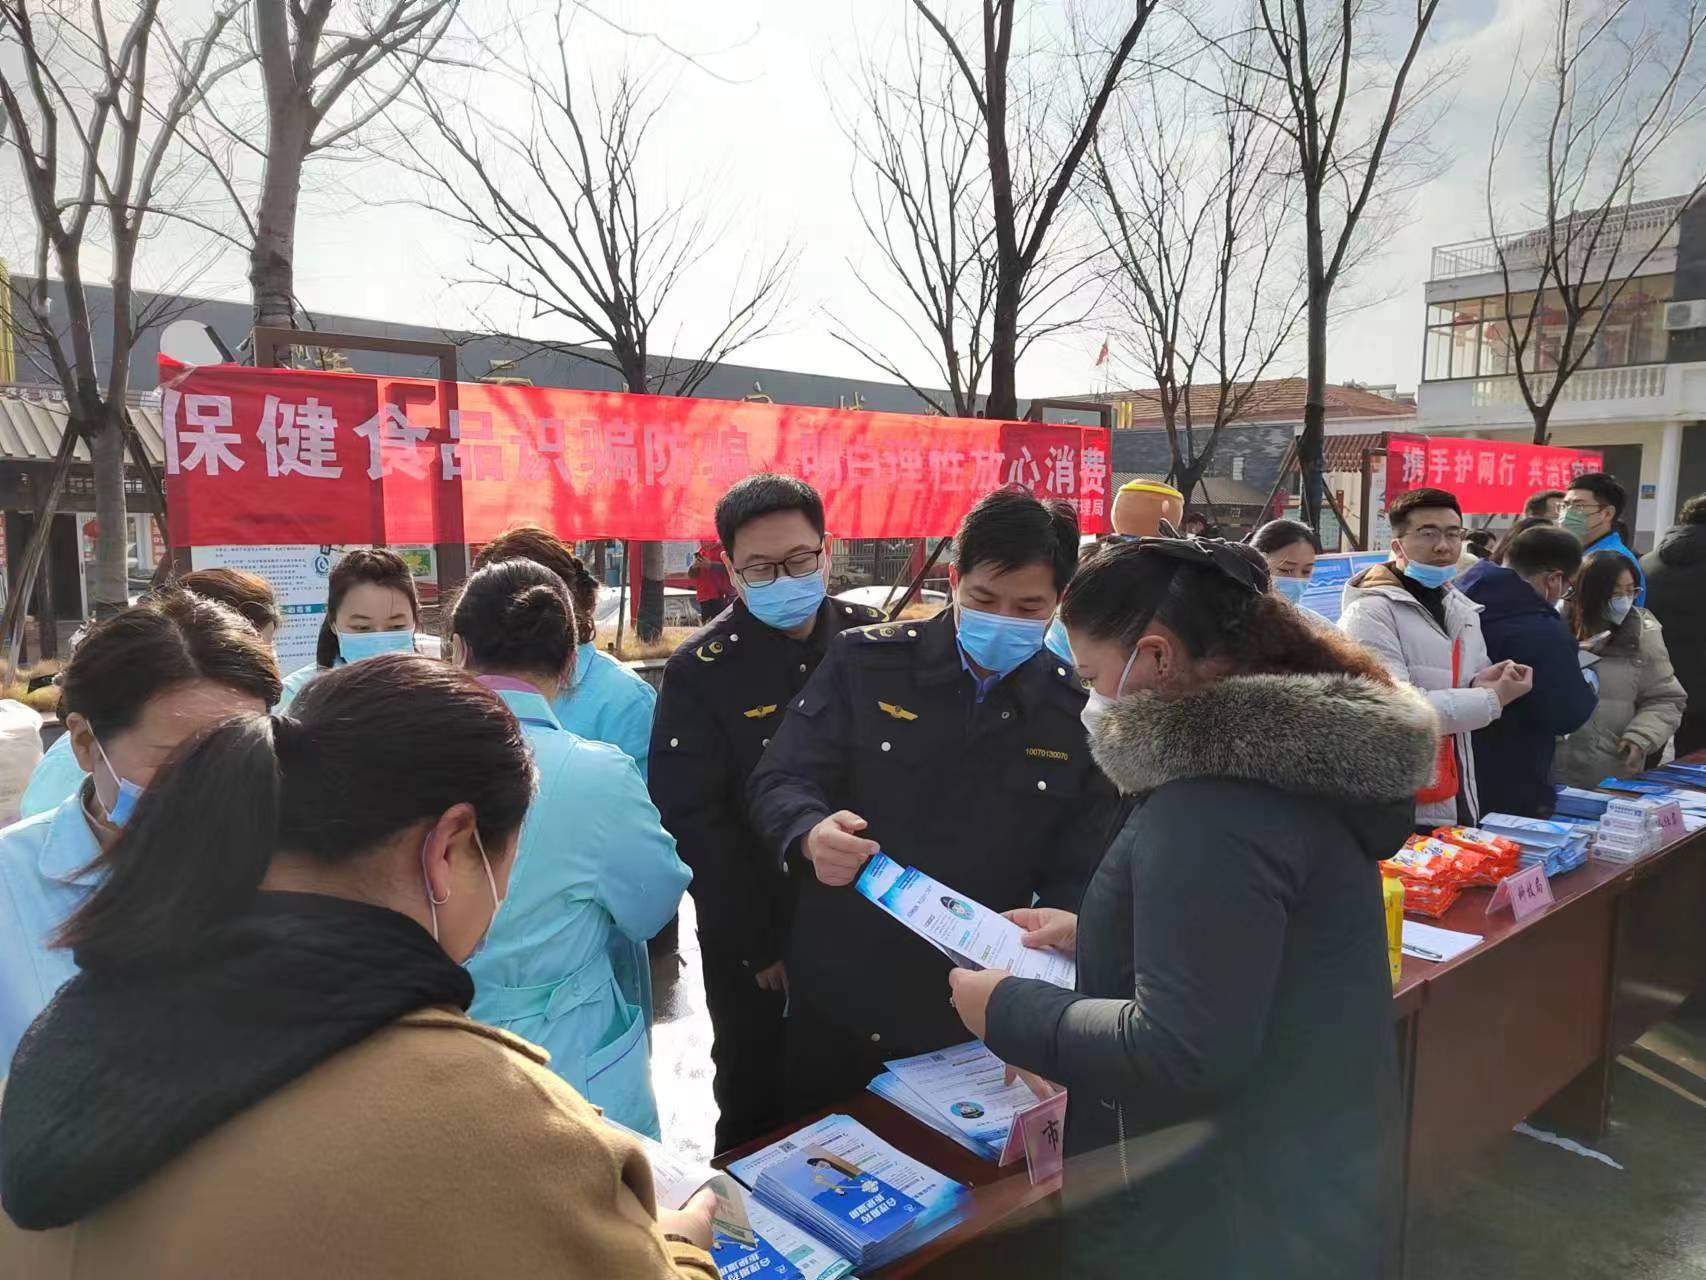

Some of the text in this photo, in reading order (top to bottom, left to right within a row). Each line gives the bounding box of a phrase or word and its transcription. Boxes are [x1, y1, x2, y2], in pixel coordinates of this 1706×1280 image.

[1402, 446, 1517, 487] 携手护网行
[1041, 1119, 1060, 1152] 市
